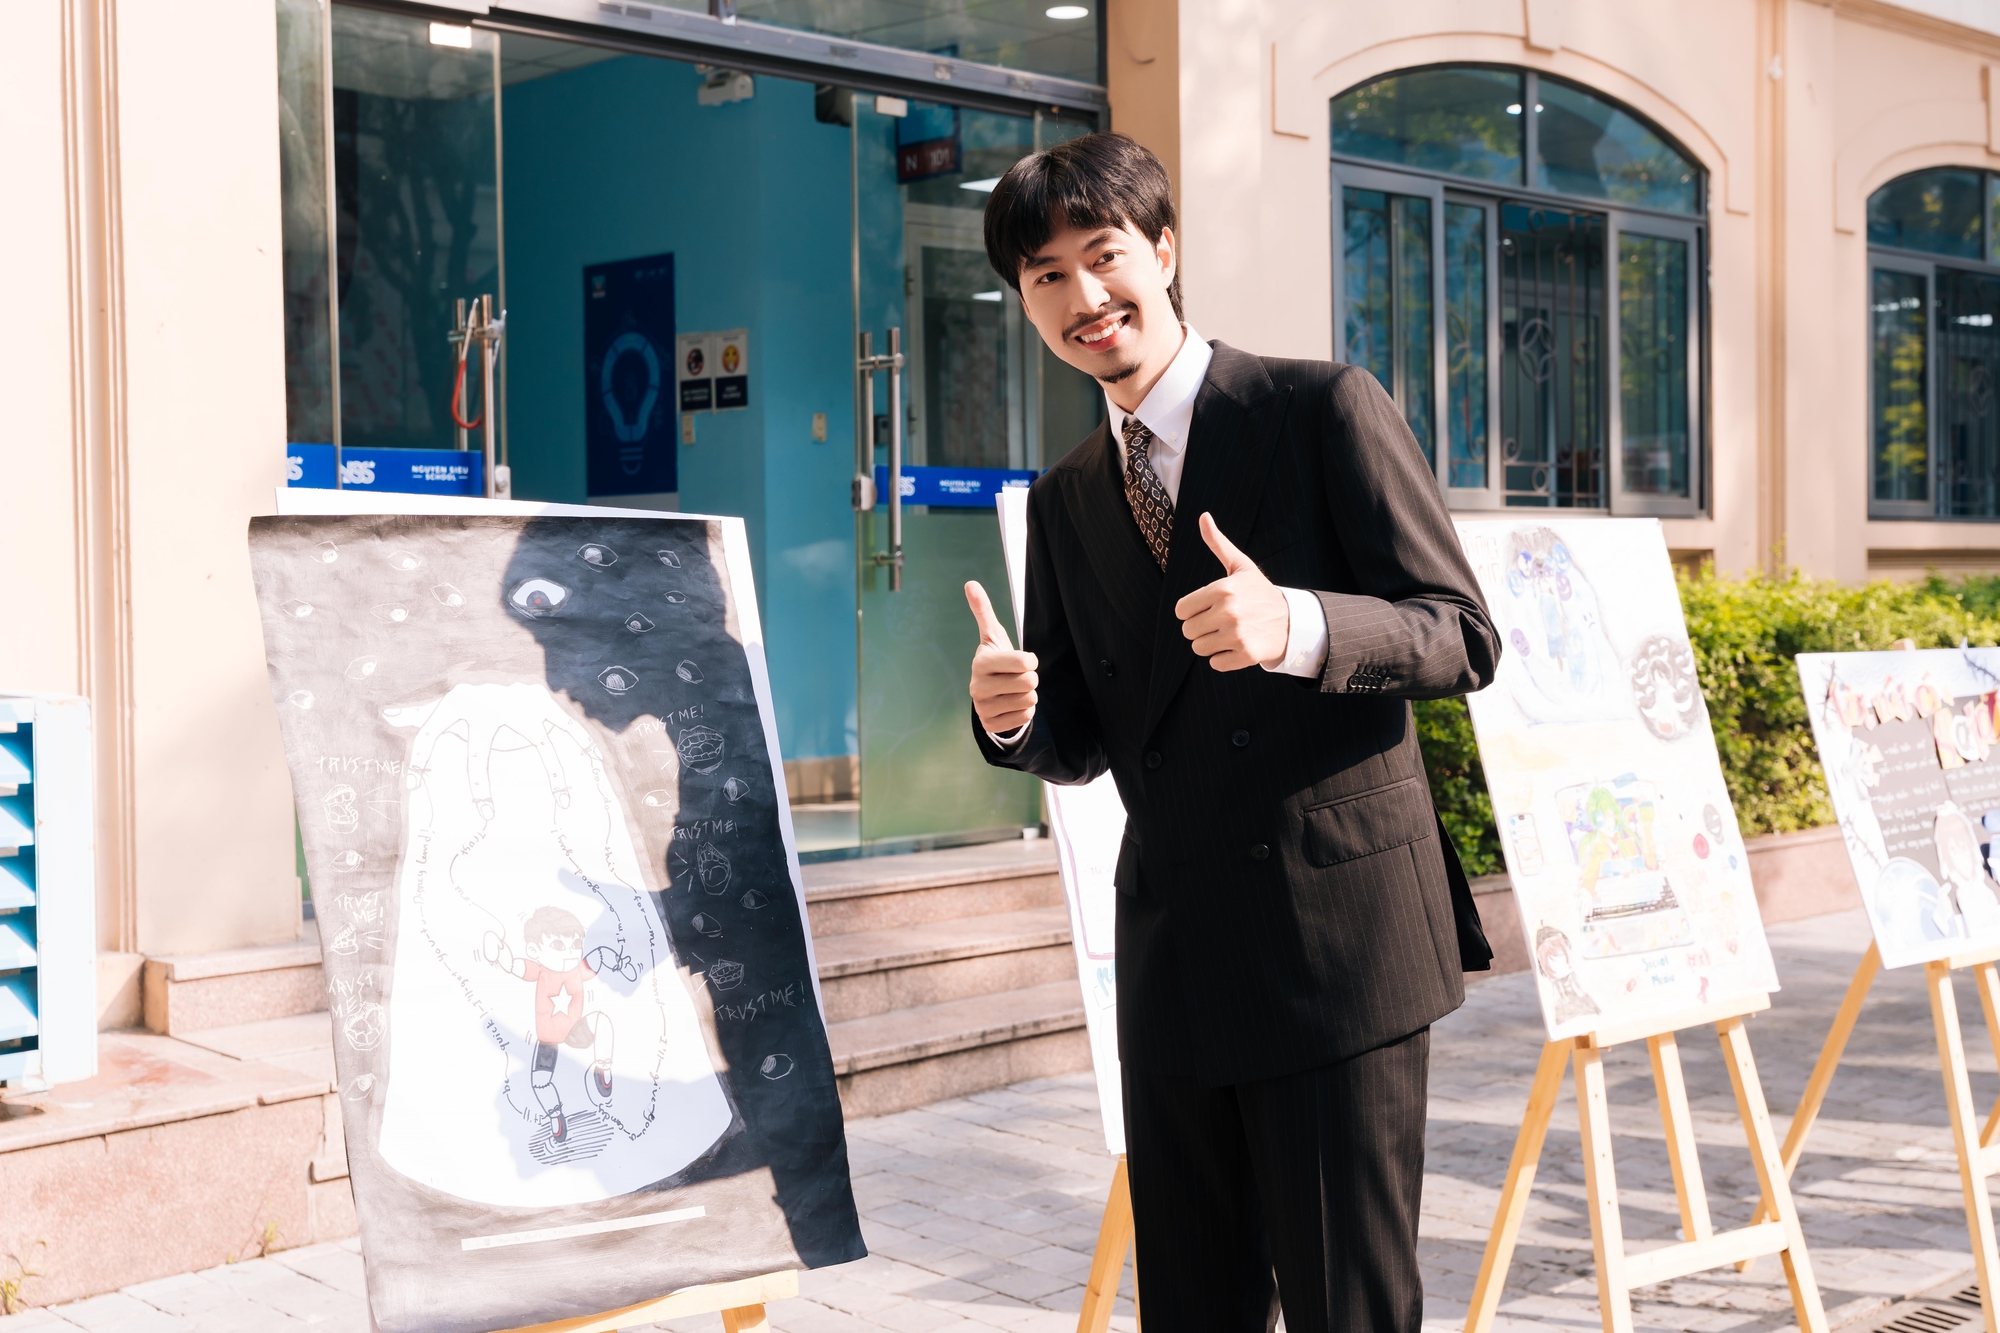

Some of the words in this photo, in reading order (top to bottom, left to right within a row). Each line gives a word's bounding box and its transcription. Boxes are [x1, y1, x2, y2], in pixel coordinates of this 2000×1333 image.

[905, 153, 918, 172] N
[929, 147, 950, 167] 101
[411, 464, 447, 474] NGUYEN
[449, 465, 469, 474] SIEU
[425, 473, 456, 481] SCHOOL
[634, 711, 675, 737] TRUST
[678, 704, 704, 721] ME!
[317, 755, 373, 774] TRUST
[375, 759, 405, 777] ME!
[668, 820, 709, 841] TRUST
[712, 819, 739, 838] ME!
[573, 867, 600, 894] good
[333, 890, 382, 911] TRUST
[604, 845, 615, 874] this
[633, 893, 647, 914] for
[648, 929, 656, 948] me
[353, 906, 383, 926] ME!
[713, 993, 766, 1022] TRUST
[770, 981, 806, 1007] ME!
